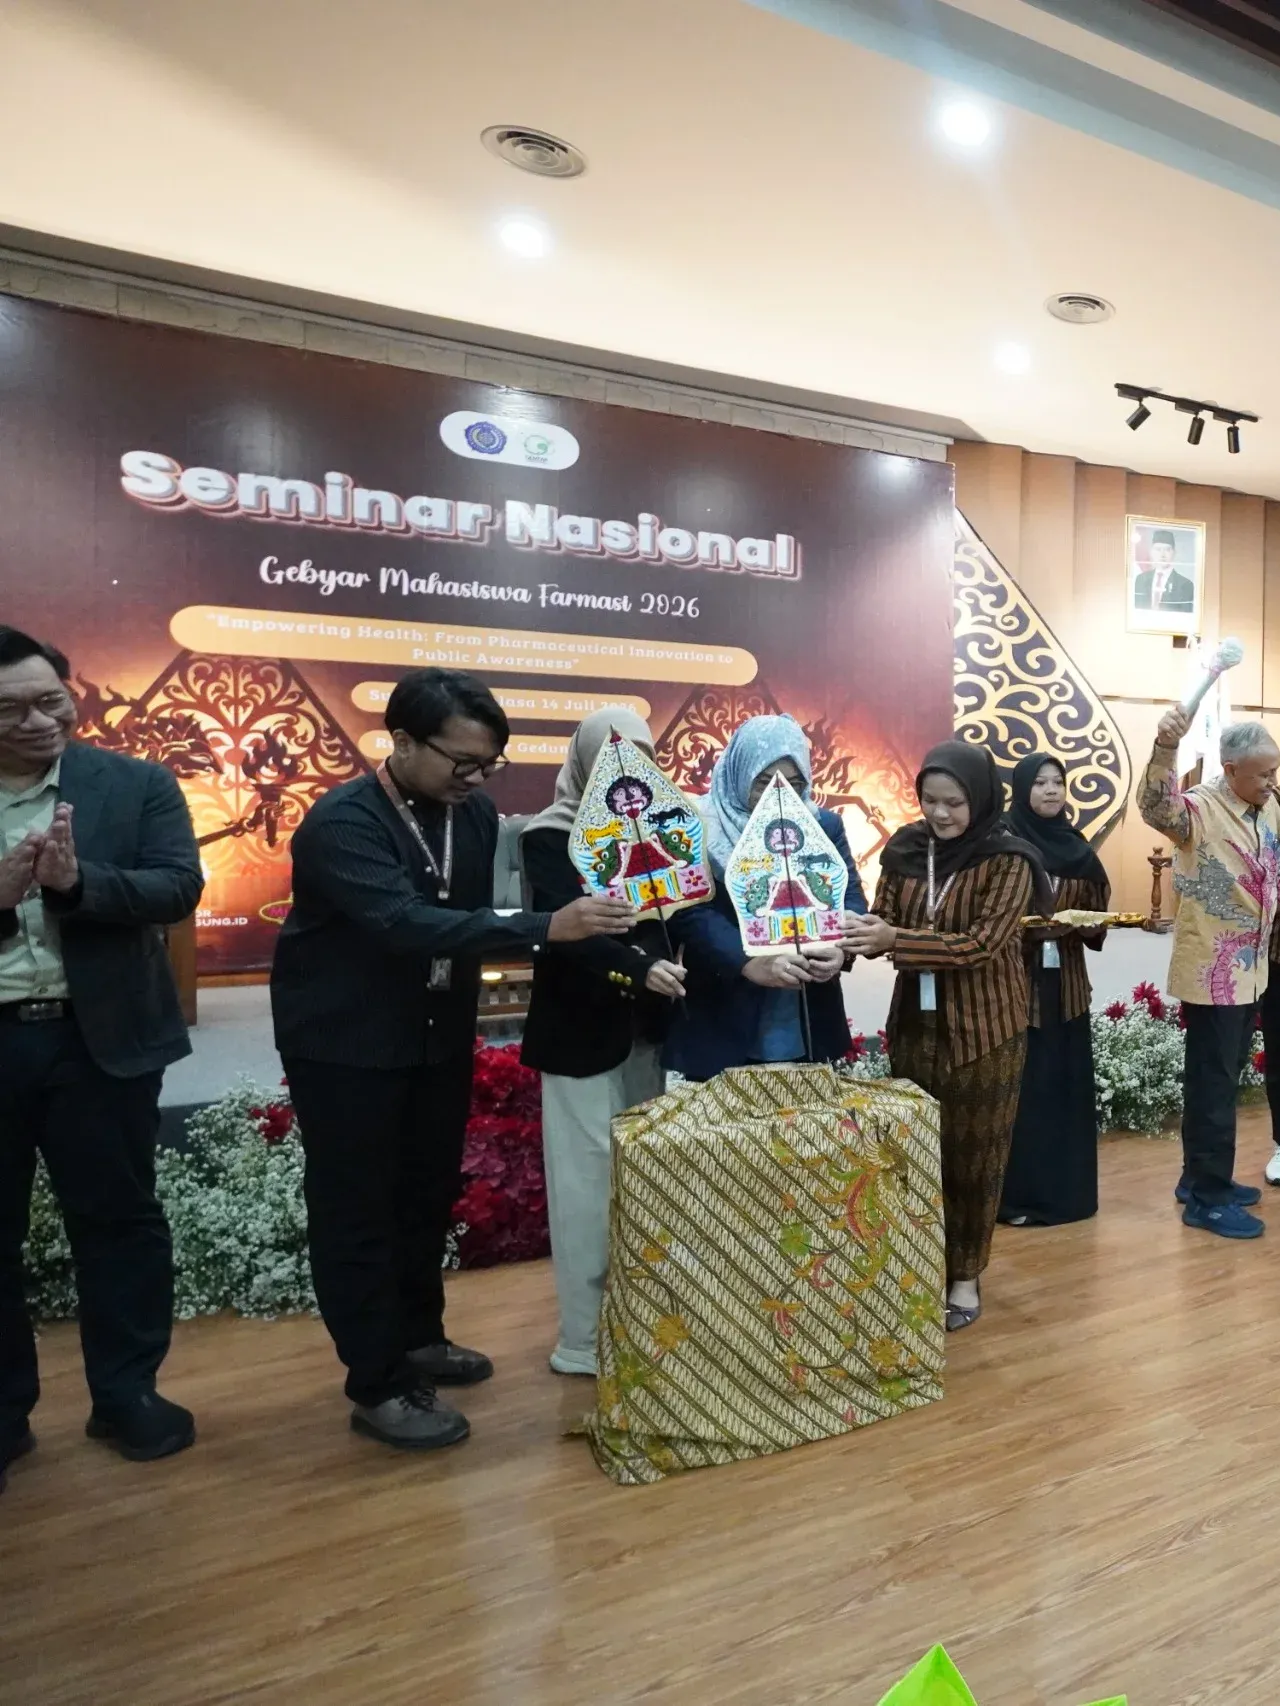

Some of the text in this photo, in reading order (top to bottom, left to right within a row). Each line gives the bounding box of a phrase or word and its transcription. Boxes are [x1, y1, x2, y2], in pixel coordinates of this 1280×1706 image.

[120, 450, 798, 577] Seminar Nasional
[259, 555, 700, 618] Gebyar Mahasiswa Farmasi 2026
[357, 625, 429, 643] Health:
[435, 631, 483, 646] From
[488, 635, 624, 655] Pharmaceutical
[630, 646, 714, 663] Innovation
[718, 653, 734, 664] to
[412, 648, 470, 663] Public
[542, 698, 558, 710] 14
[564, 699, 594, 711] Juli
[517, 742, 570, 754] Gedun
